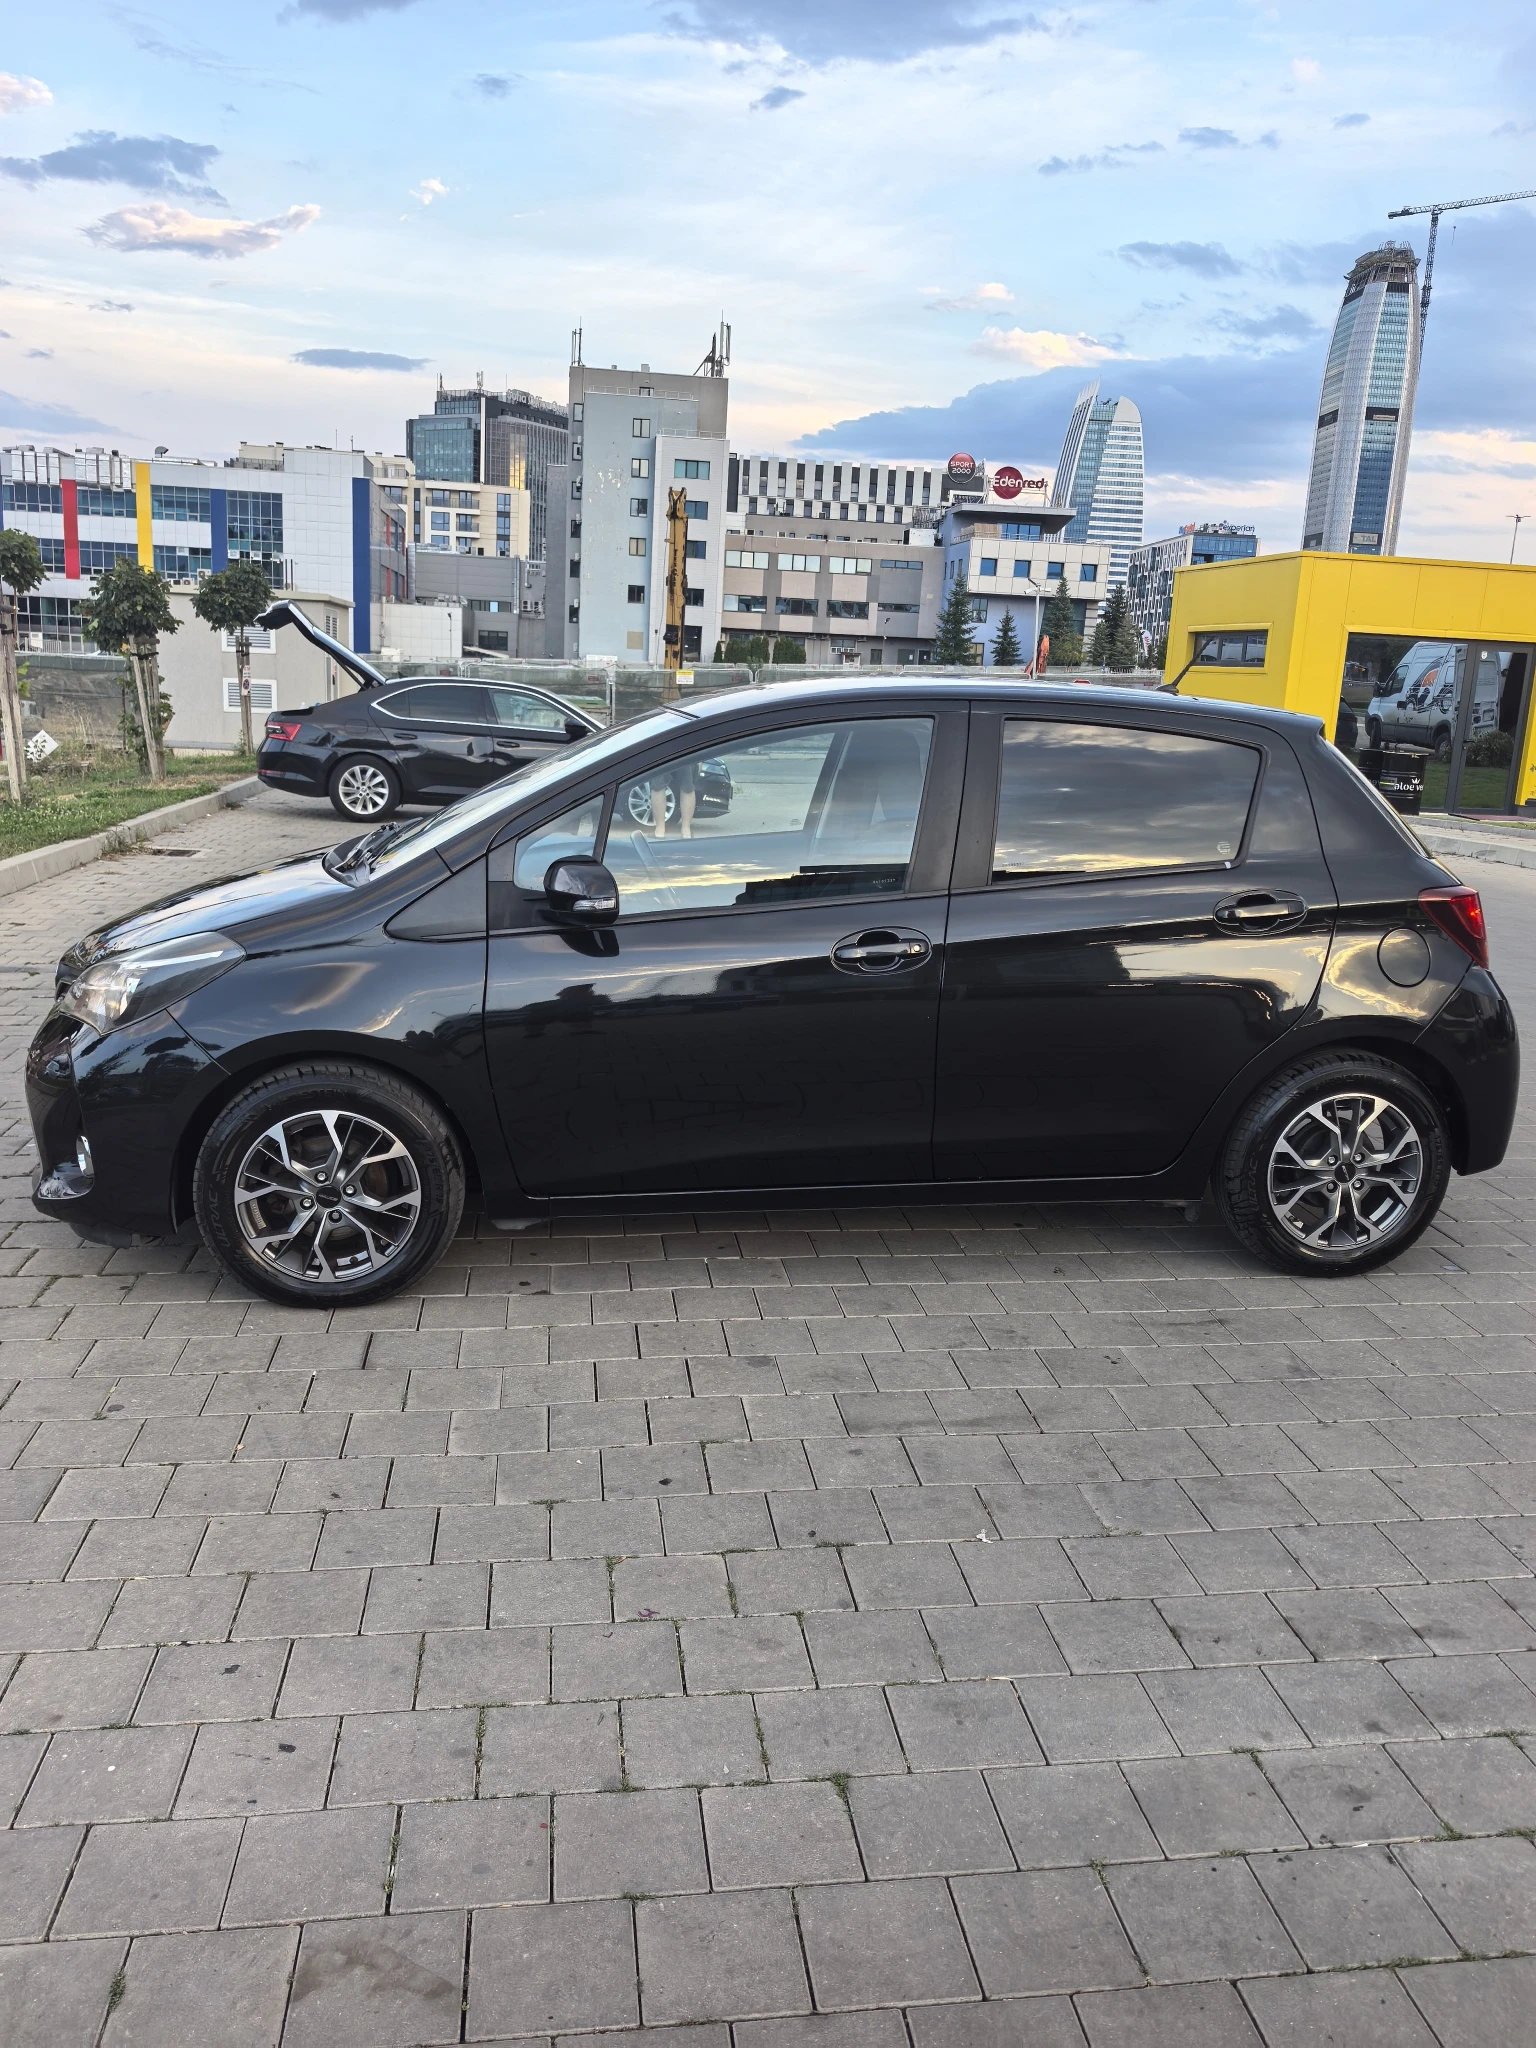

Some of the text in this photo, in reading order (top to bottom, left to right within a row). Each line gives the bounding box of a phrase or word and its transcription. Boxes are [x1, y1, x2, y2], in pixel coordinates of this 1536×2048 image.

[993, 475, 1045, 489] Edenred
[1222, 524, 1256, 533] experian
[1394, 782, 1415, 791] aloe
[1247, 1157, 1260, 1211] ULTRAC
[208, 1189, 231, 1247] ULTRAC
